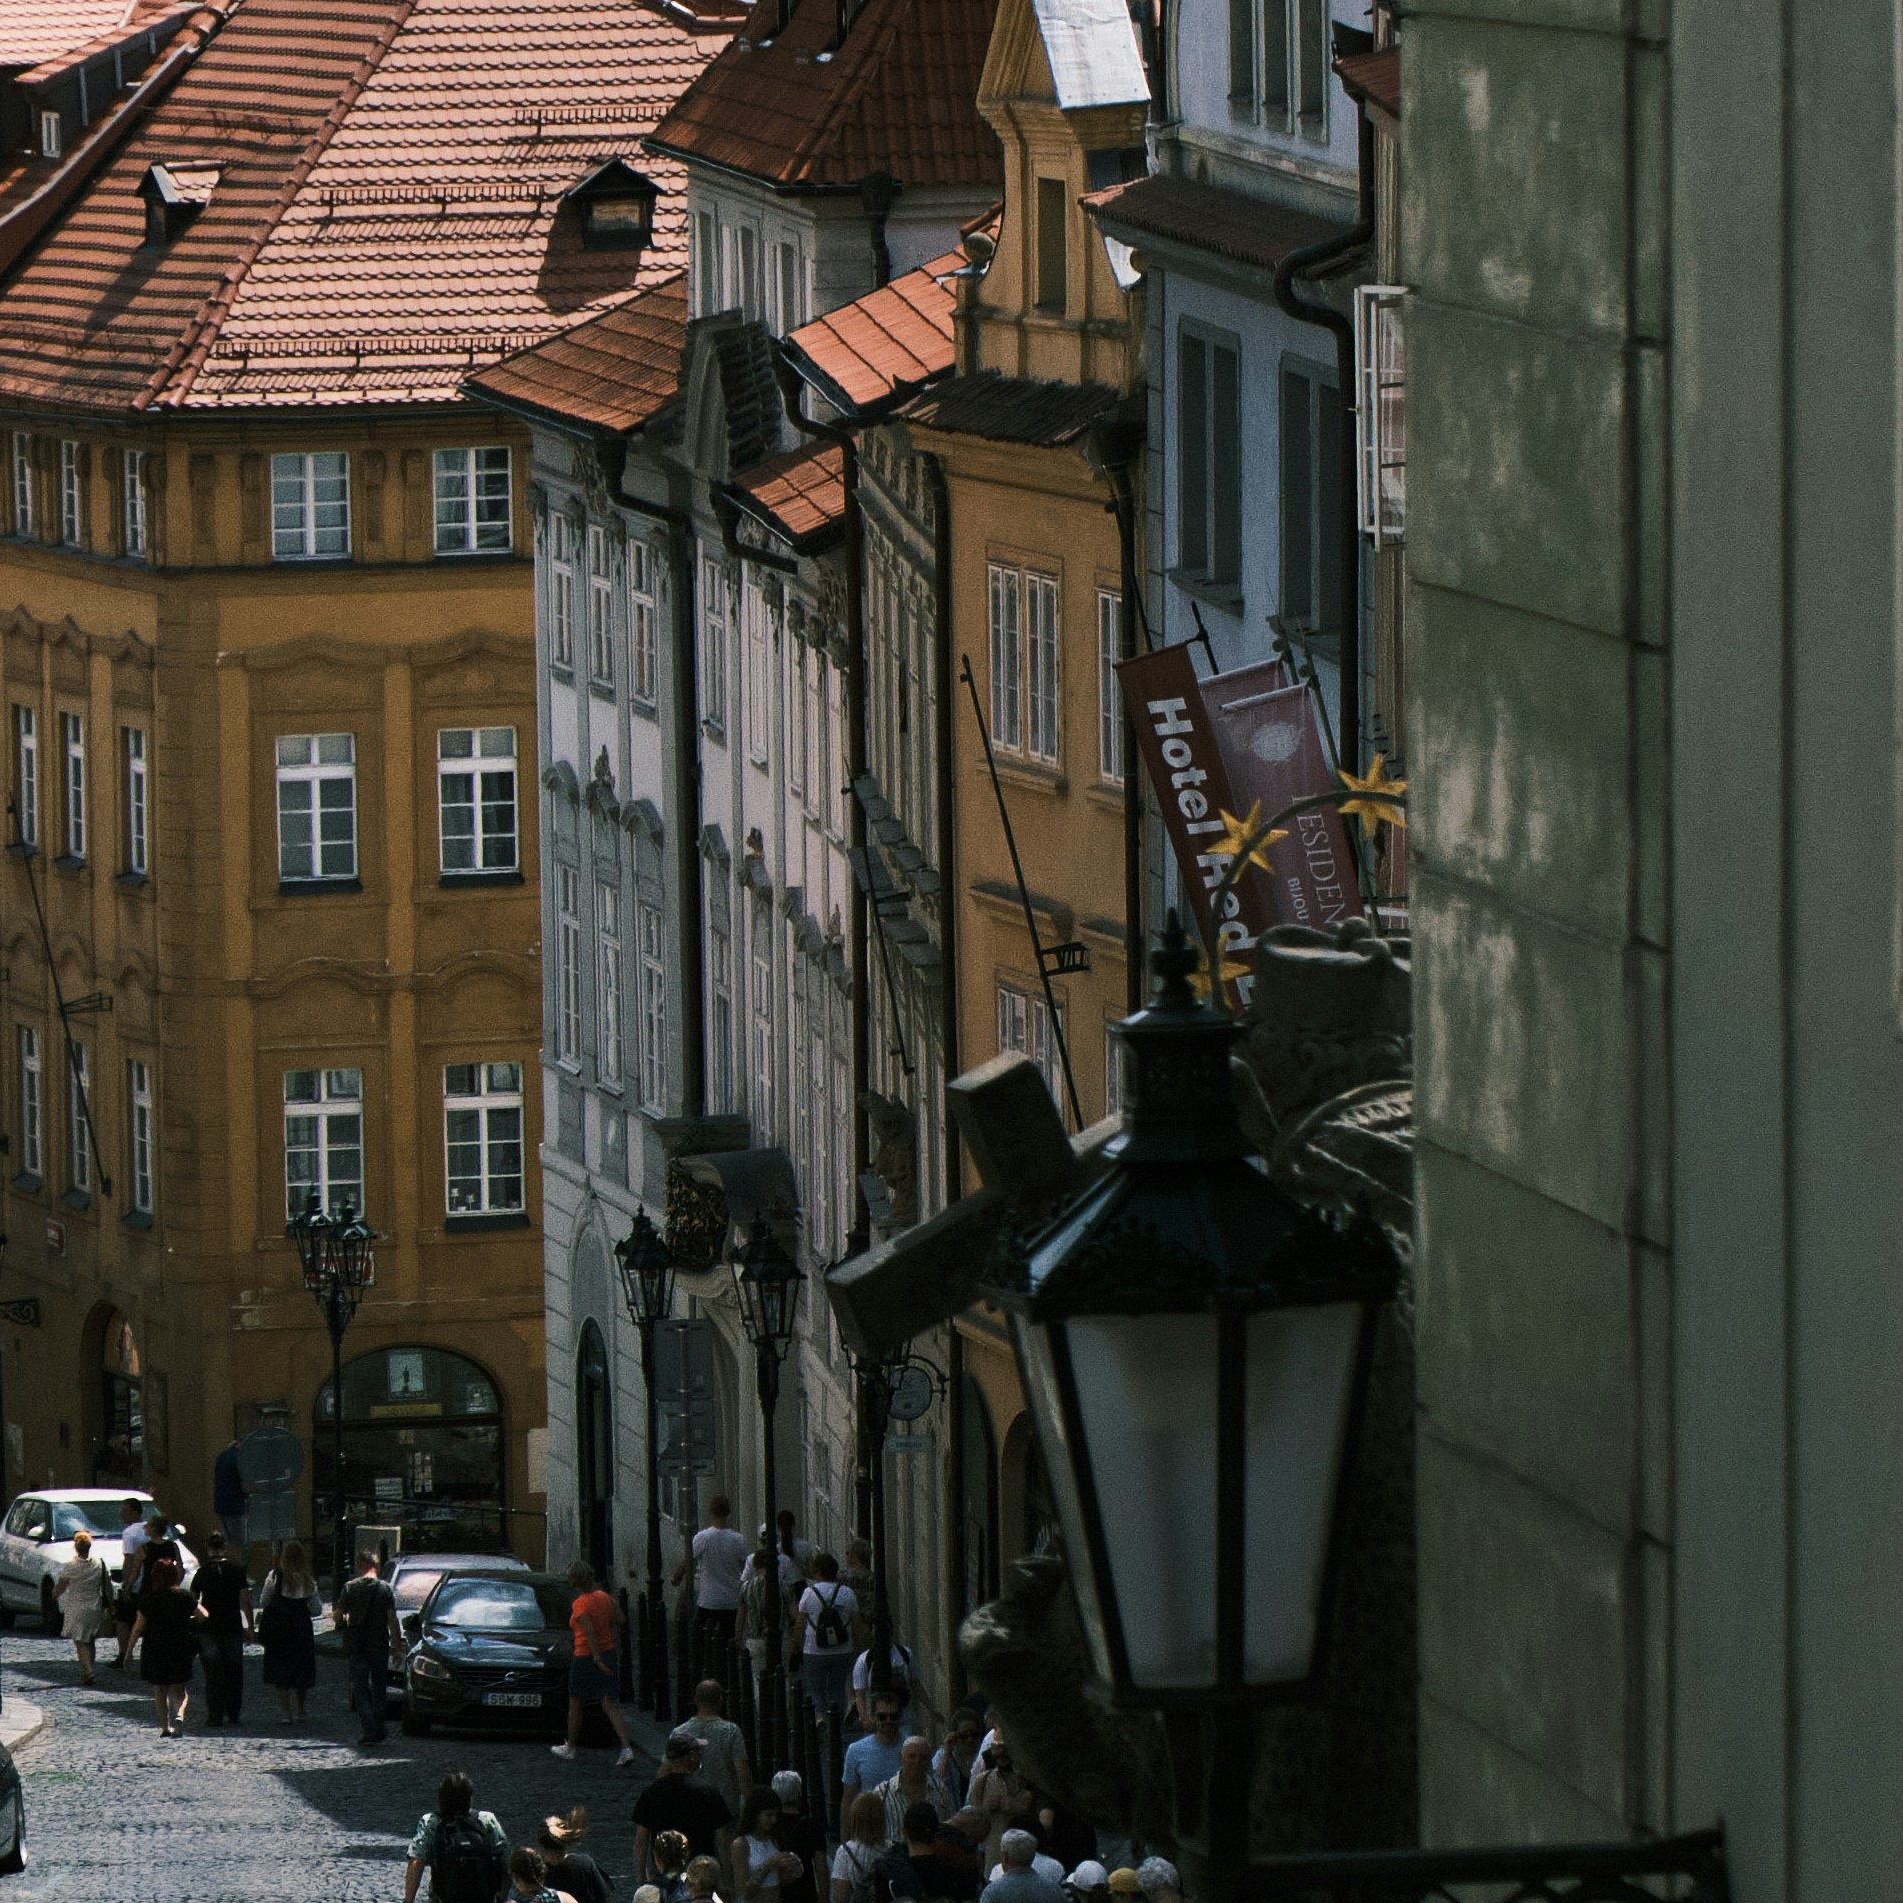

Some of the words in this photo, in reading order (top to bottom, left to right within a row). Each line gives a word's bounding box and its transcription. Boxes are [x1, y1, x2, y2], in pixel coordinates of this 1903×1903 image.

[1147, 696, 1225, 835] Hotel
[1287, 876, 1310, 921] BIJOU
[1291, 792, 1347, 929] ESIDEN
